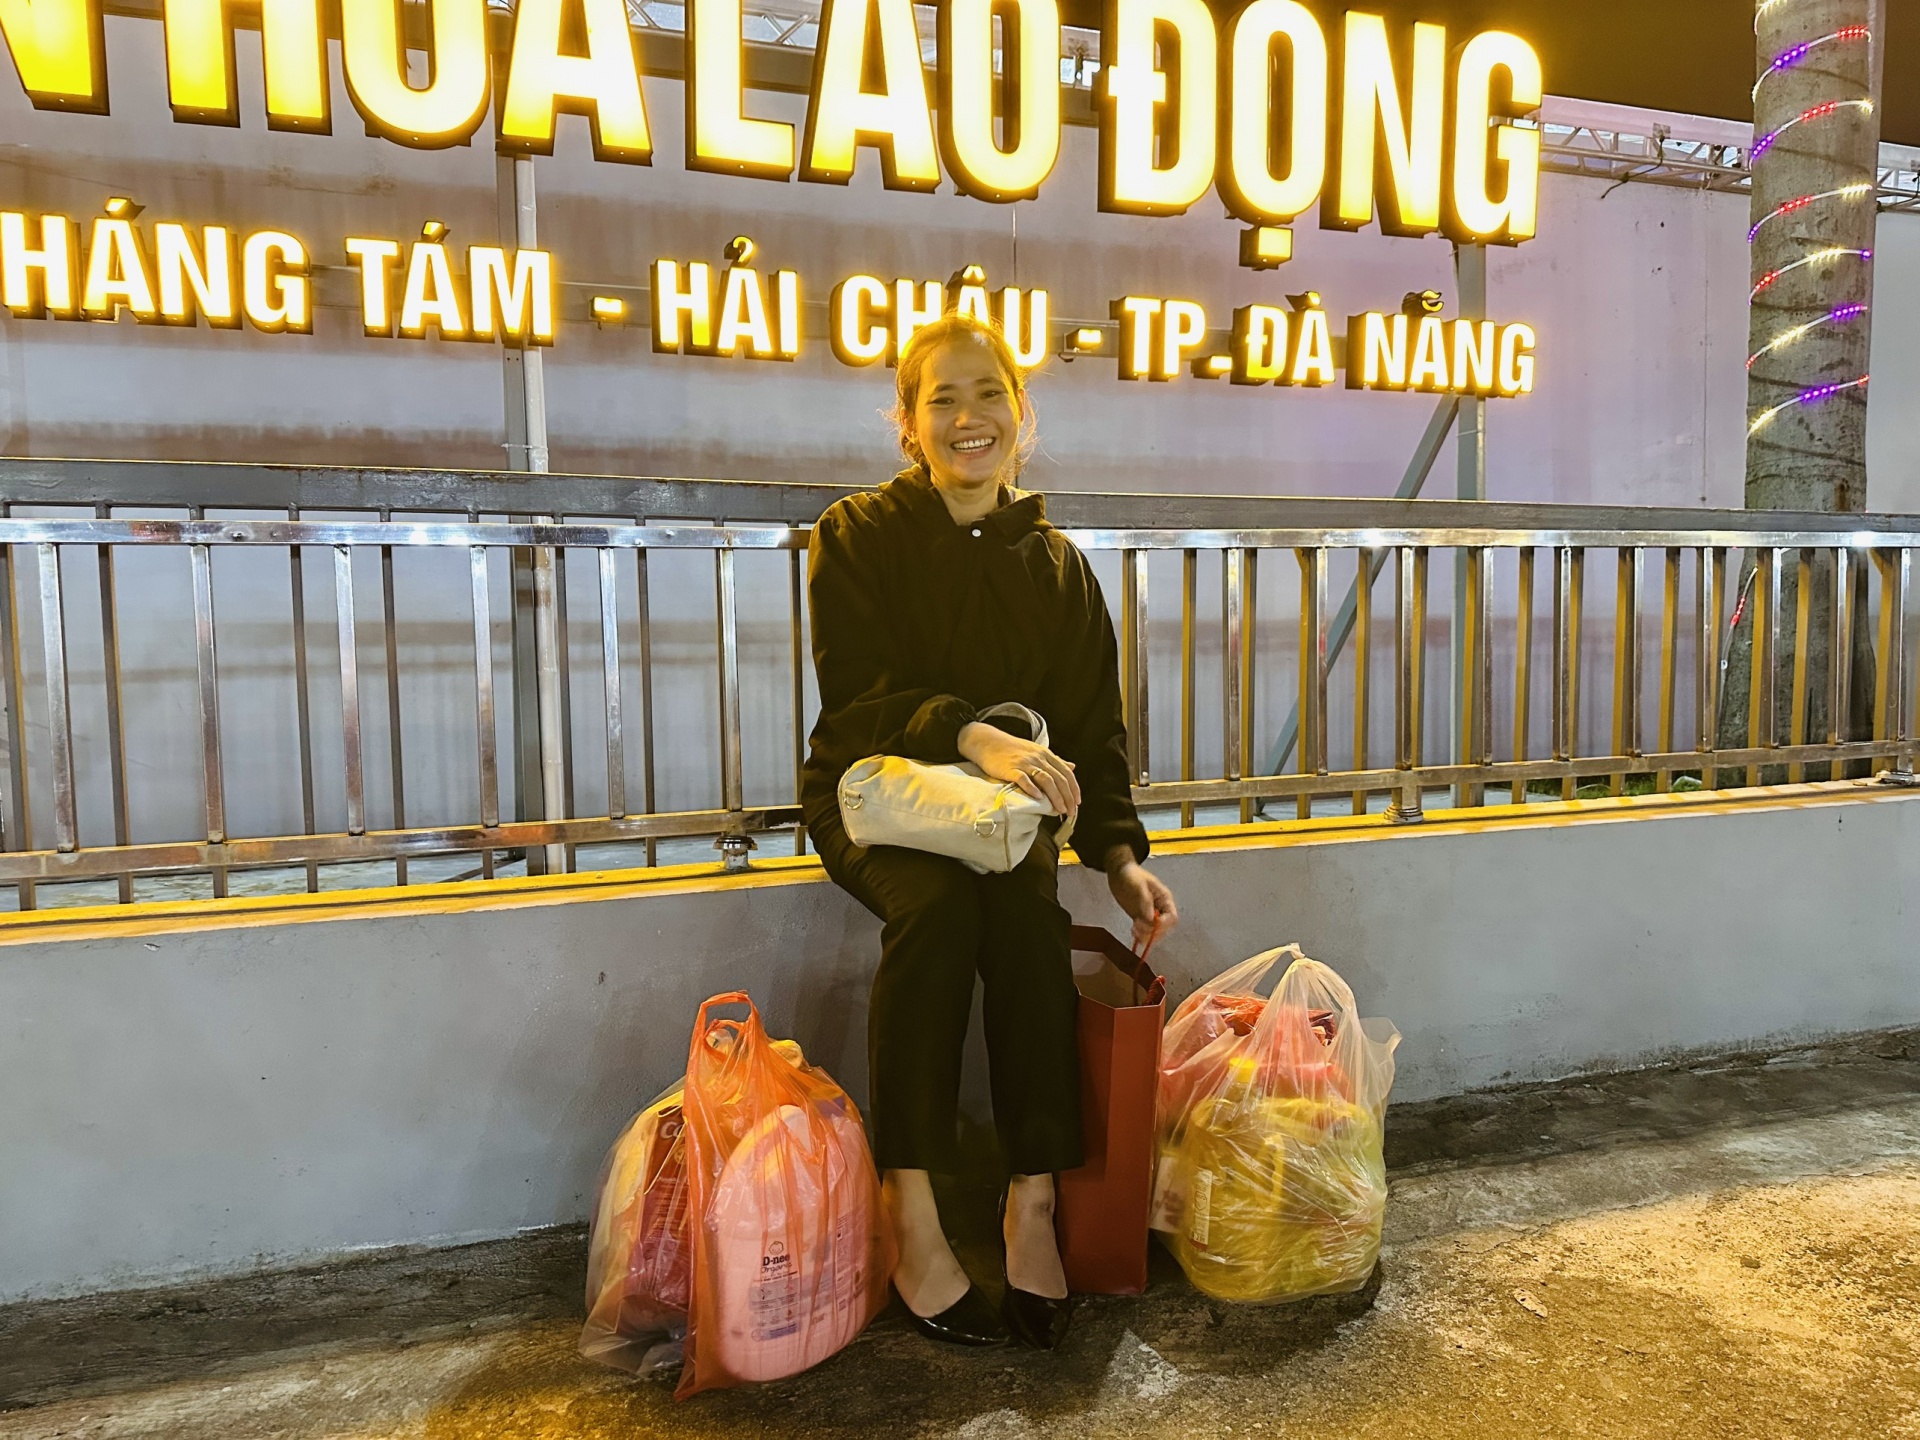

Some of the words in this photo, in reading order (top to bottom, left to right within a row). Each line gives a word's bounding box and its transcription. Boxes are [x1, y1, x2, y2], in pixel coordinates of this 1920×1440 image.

[696, 0, 1059, 191] LAO
[0, 198, 306, 326] HÁNG
[346, 221, 551, 336] TÁM
[656, 236, 798, 355] HẢI
[841, 265, 1048, 367] CHÂU
[1364, 289, 1536, 393] NẴNG
[763, 1253, 790, 1267] D-nee
